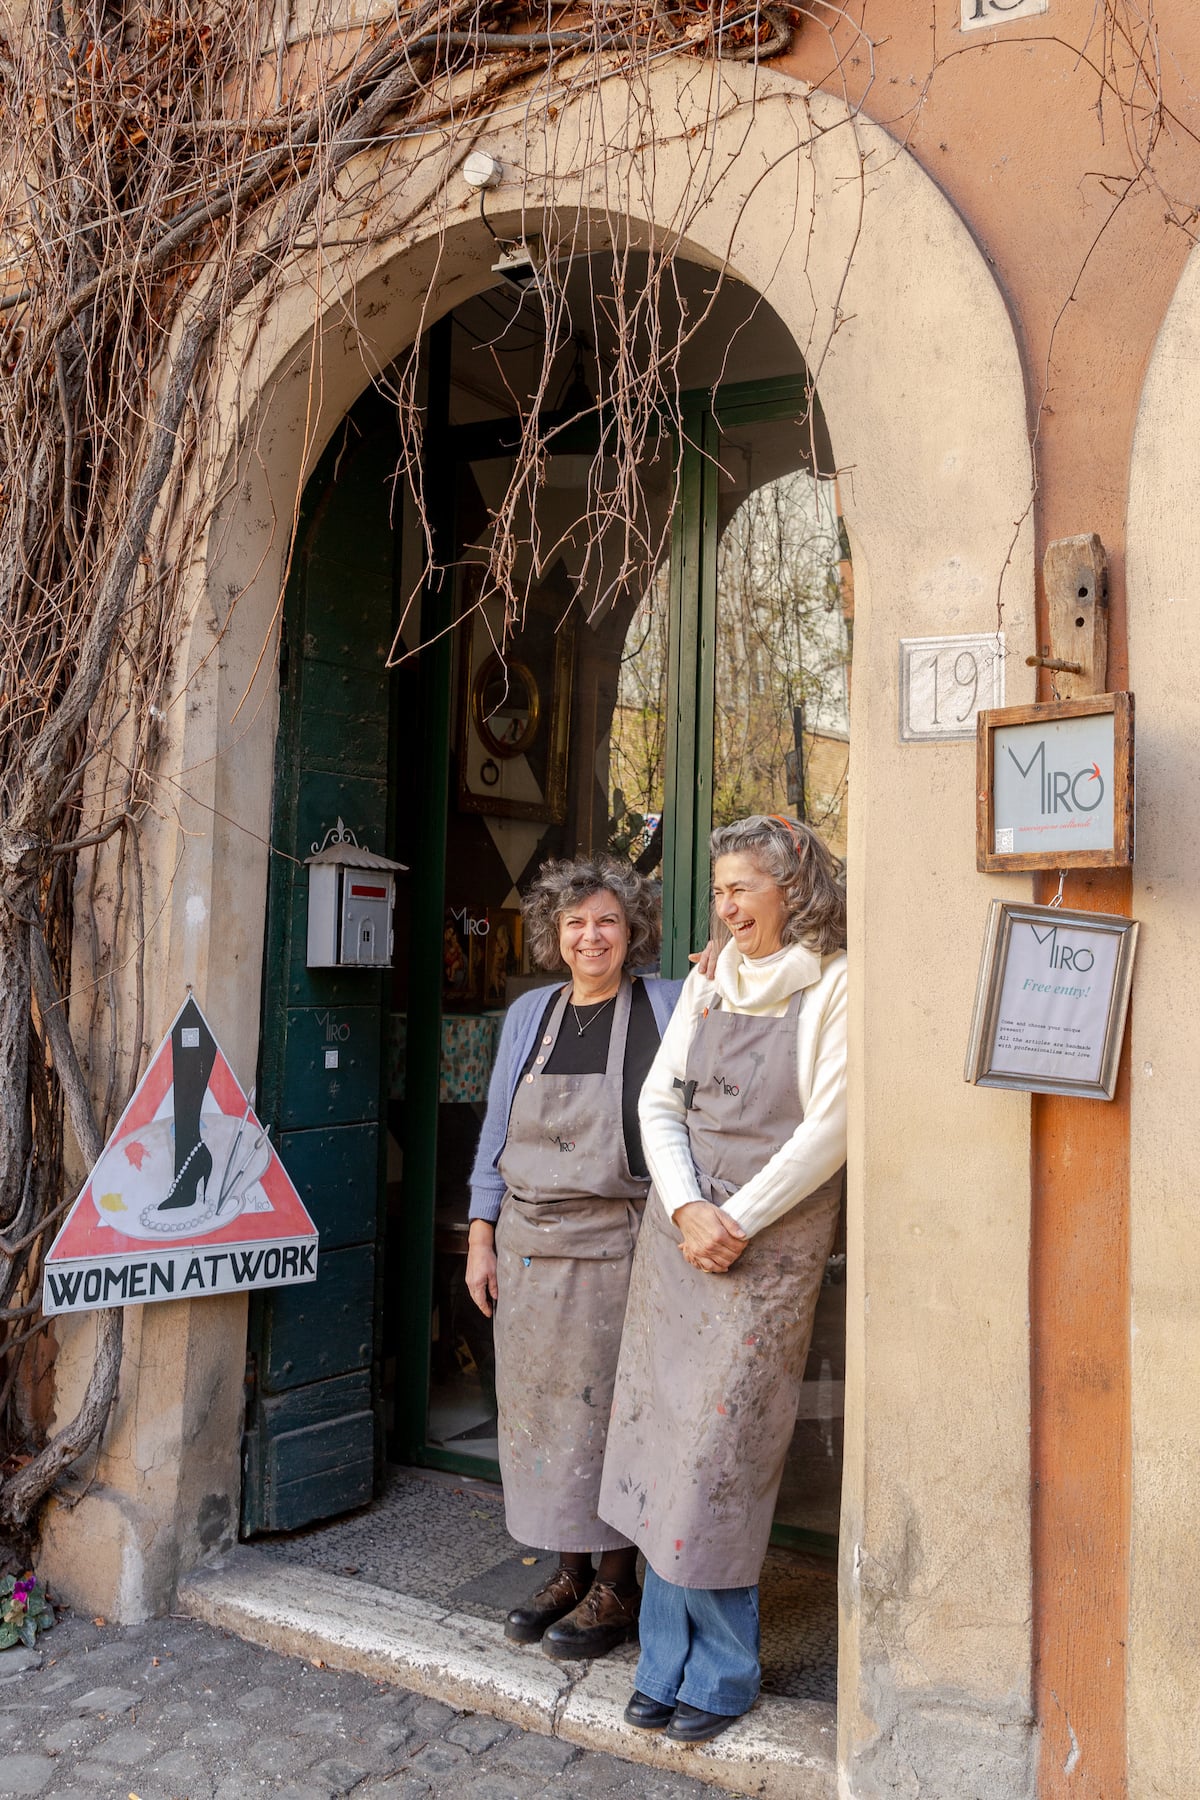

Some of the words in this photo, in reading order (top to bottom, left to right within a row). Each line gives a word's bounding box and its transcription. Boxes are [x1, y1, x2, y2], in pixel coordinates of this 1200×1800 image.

[928, 651, 978, 725] 19
[1022, 978, 1051, 992] Free
[1053, 984, 1091, 1000] entry!
[47, 1259, 175, 1307] WOMEN
